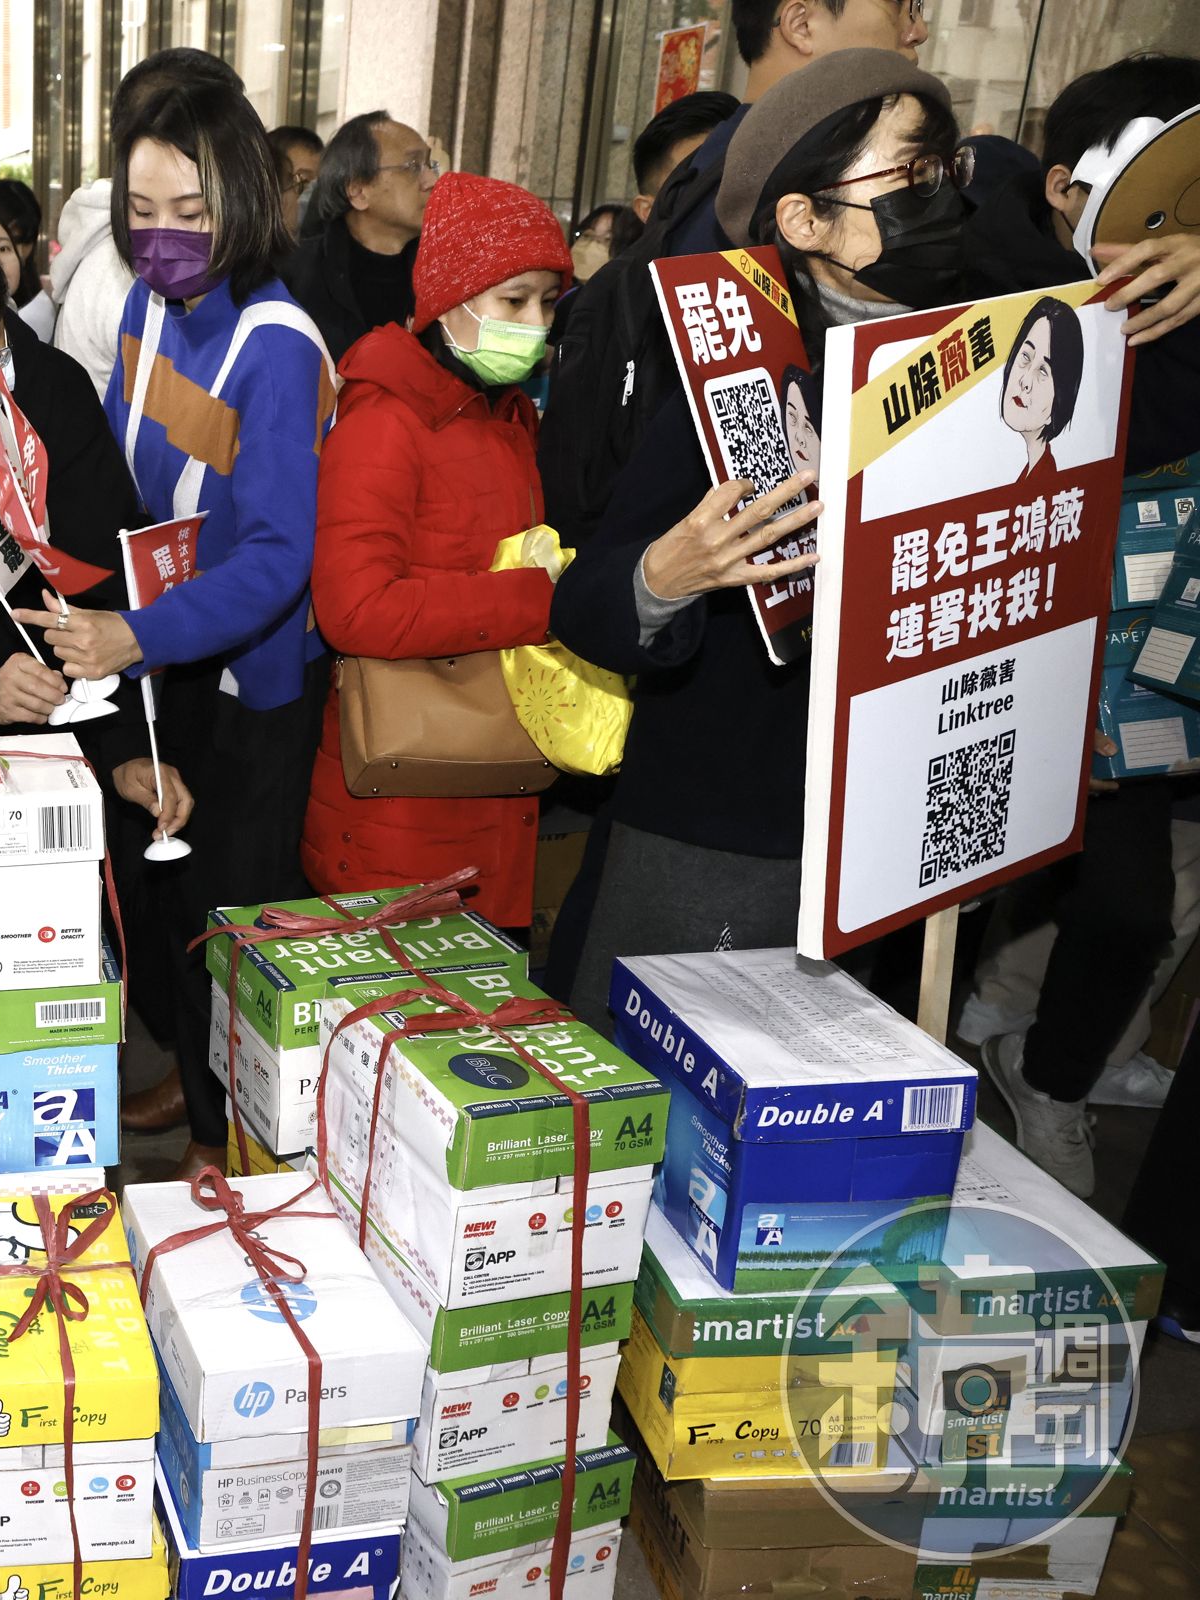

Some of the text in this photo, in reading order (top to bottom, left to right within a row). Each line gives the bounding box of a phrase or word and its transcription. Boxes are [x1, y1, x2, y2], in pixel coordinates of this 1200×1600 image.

[752, 267, 793, 315] 山除薇害
[674, 276, 763, 367] 罷免
[882, 315, 997, 436] 山除薇害
[890, 487, 1085, 597] 罷免王鴻薇
[885, 563, 1057, 664] 連署找我!
[940, 658, 1017, 706] 山除薇害
[937, 693, 1014, 735] Linktree
[8, 810, 23, 821] 70
[256, 990, 273, 1019] A4
[624, 988, 718, 1098] Double A
[22, 1053, 86, 1067] Smoother
[47, 1063, 99, 1075] Thicker
[465, 1057, 513, 1085] BLC
[757, 1100, 885, 1127] Double A
[43, 1124, 76, 1132] Double
[616, 1112, 653, 1141] A4
[690, 1114, 729, 1155] Smoother
[487, 1132, 568, 1152] Brilliant Laser
[614, 1138, 653, 1151] 70 GSM
[702, 1140, 733, 1174] Thicker
[463, 1230, 495, 1239] IMPROVED!
[464, 1220, 497, 1233] NEW!
[486, 1250, 516, 1266] APP
[581, 1296, 616, 1323] A4
[978, 1284, 1093, 1318] martist
[460, 1310, 571, 1339] Brilliant Laser Copy
[593, 1318, 616, 1330] GSM
[693, 1311, 827, 1342] smartist
[285, 1385, 347, 1406] Paers
[20, 1405, 108, 1429] First Copy
[441, 1401, 472, 1415] NEW!
[828, 1415, 840, 1423] A4
[687, 1419, 822, 1446] First Copy 70
[828, 1425, 845, 1433] 500
[947, 1412, 1003, 1429] smartist
[459, 1427, 488, 1442] APP
[217, 1471, 308, 1489] HP BusinessCopy
[587, 1477, 621, 1505] A4
[599, 1498, 621, 1511] GSM
[938, 1483, 1055, 1506] martist
[474, 1514, 513, 1531] Brilliant
[519, 1506, 546, 1519] Laser
[91, 1539, 135, 1547] www.app.co.id
[343, 1552, 370, 1578] A
[37, 1576, 120, 1598] First Copy
[470, 1578, 499, 1592] NEW!
